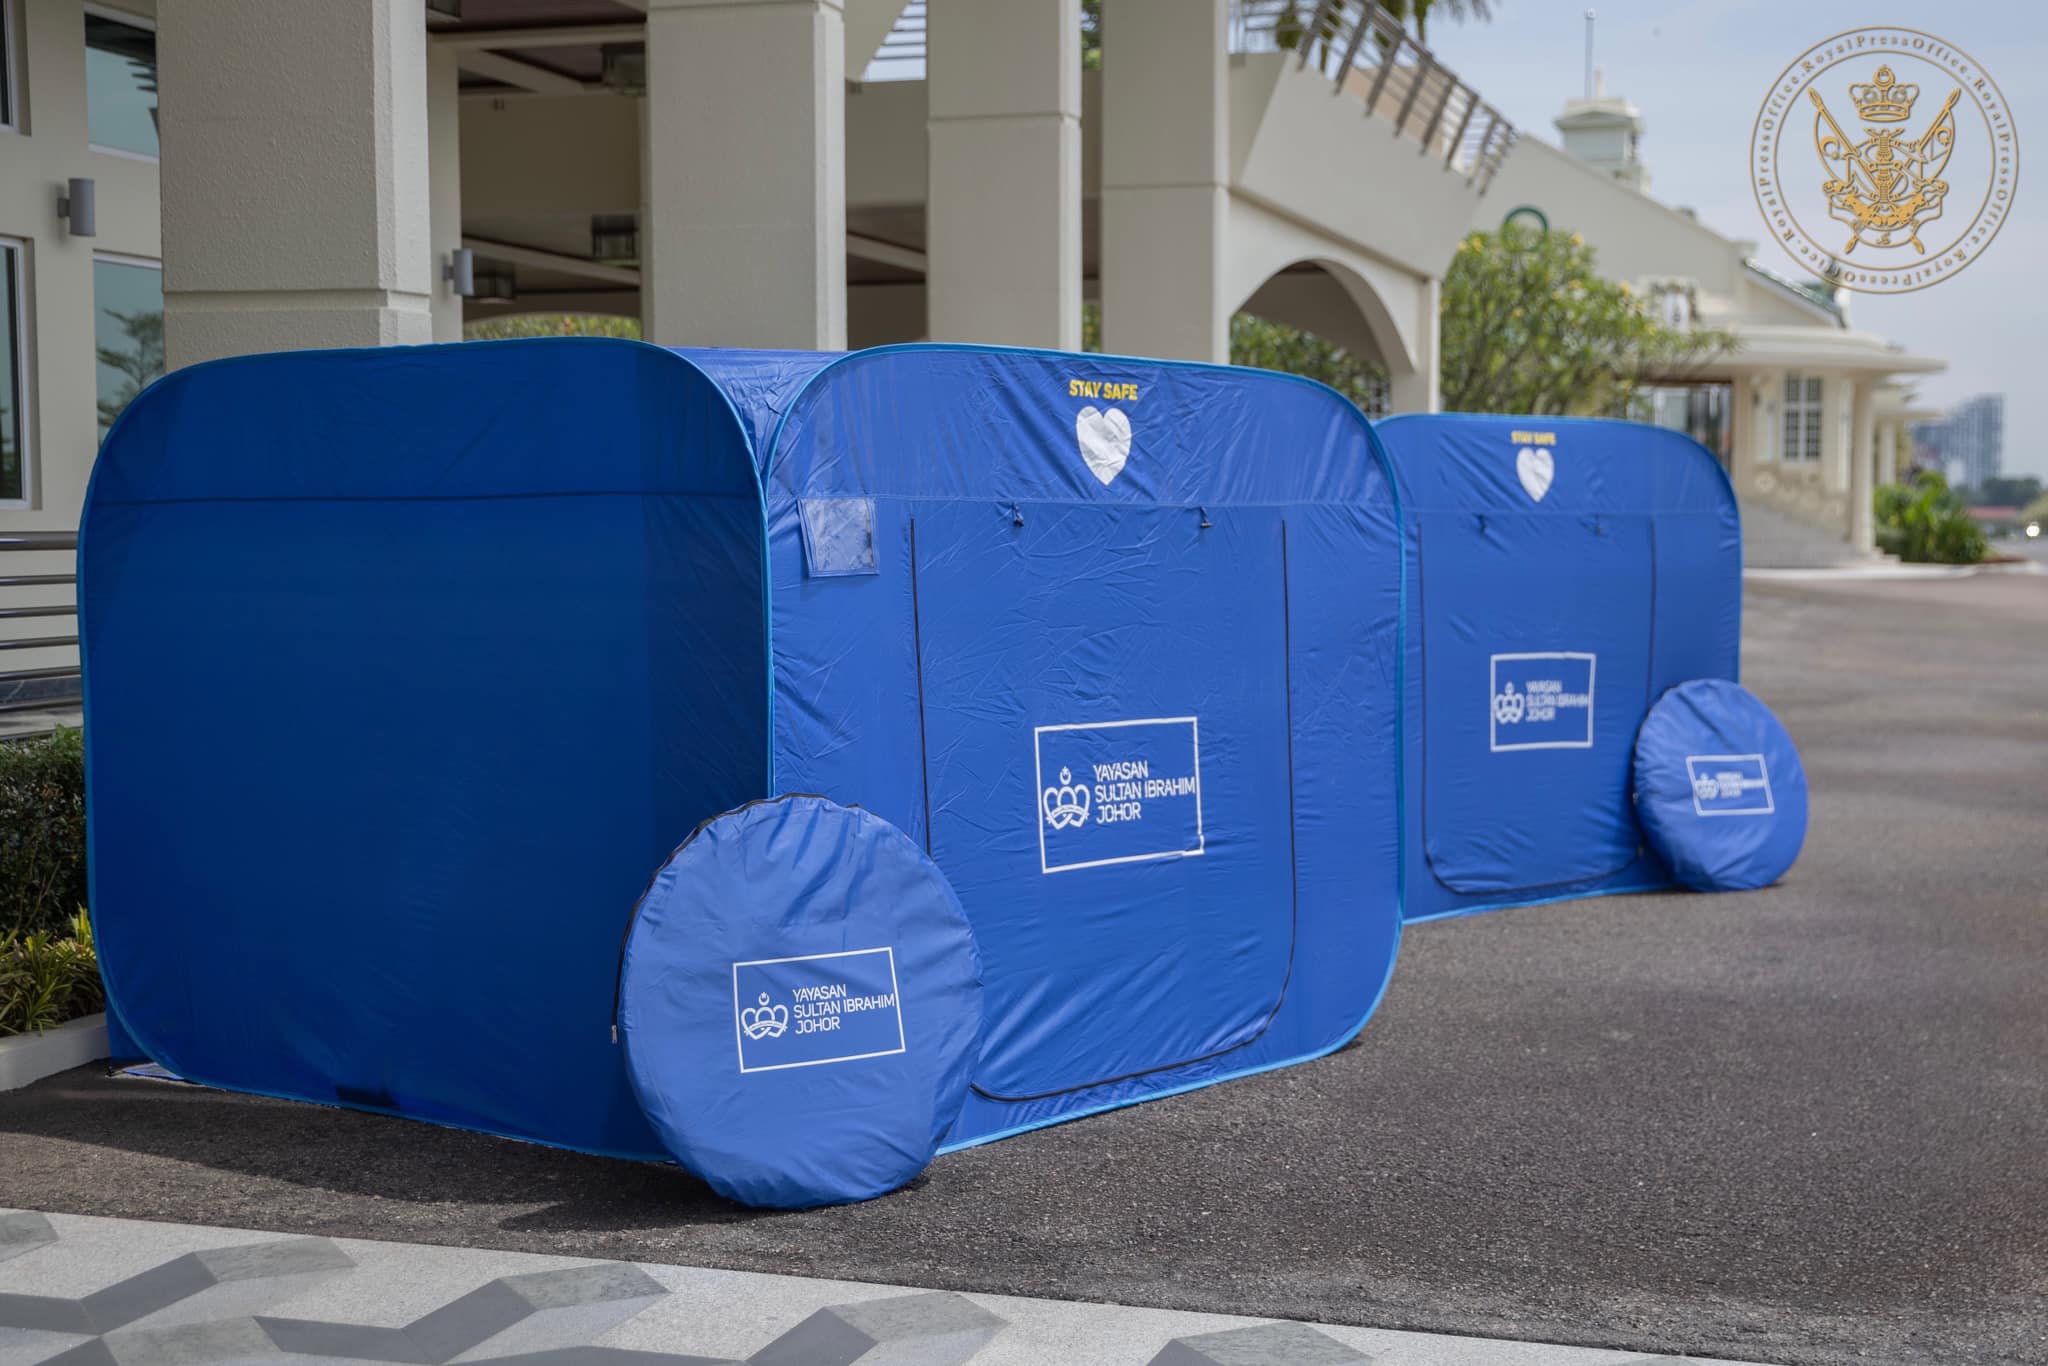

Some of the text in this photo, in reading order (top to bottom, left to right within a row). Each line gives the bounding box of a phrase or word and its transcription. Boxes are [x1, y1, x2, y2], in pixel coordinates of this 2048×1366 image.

[1069, 379, 1138, 401] STAY SAFE
[1093, 760, 1149, 782] YAYASAN
[1095, 776, 1196, 803] SULTAN IBRAHIM
[1096, 802, 1142, 824] JOHOR
[792, 984, 847, 1003] YAYASAN
[793, 993, 895, 1019] SULTAN IBRAHIM
[795, 1016, 841, 1034] JOHOR
